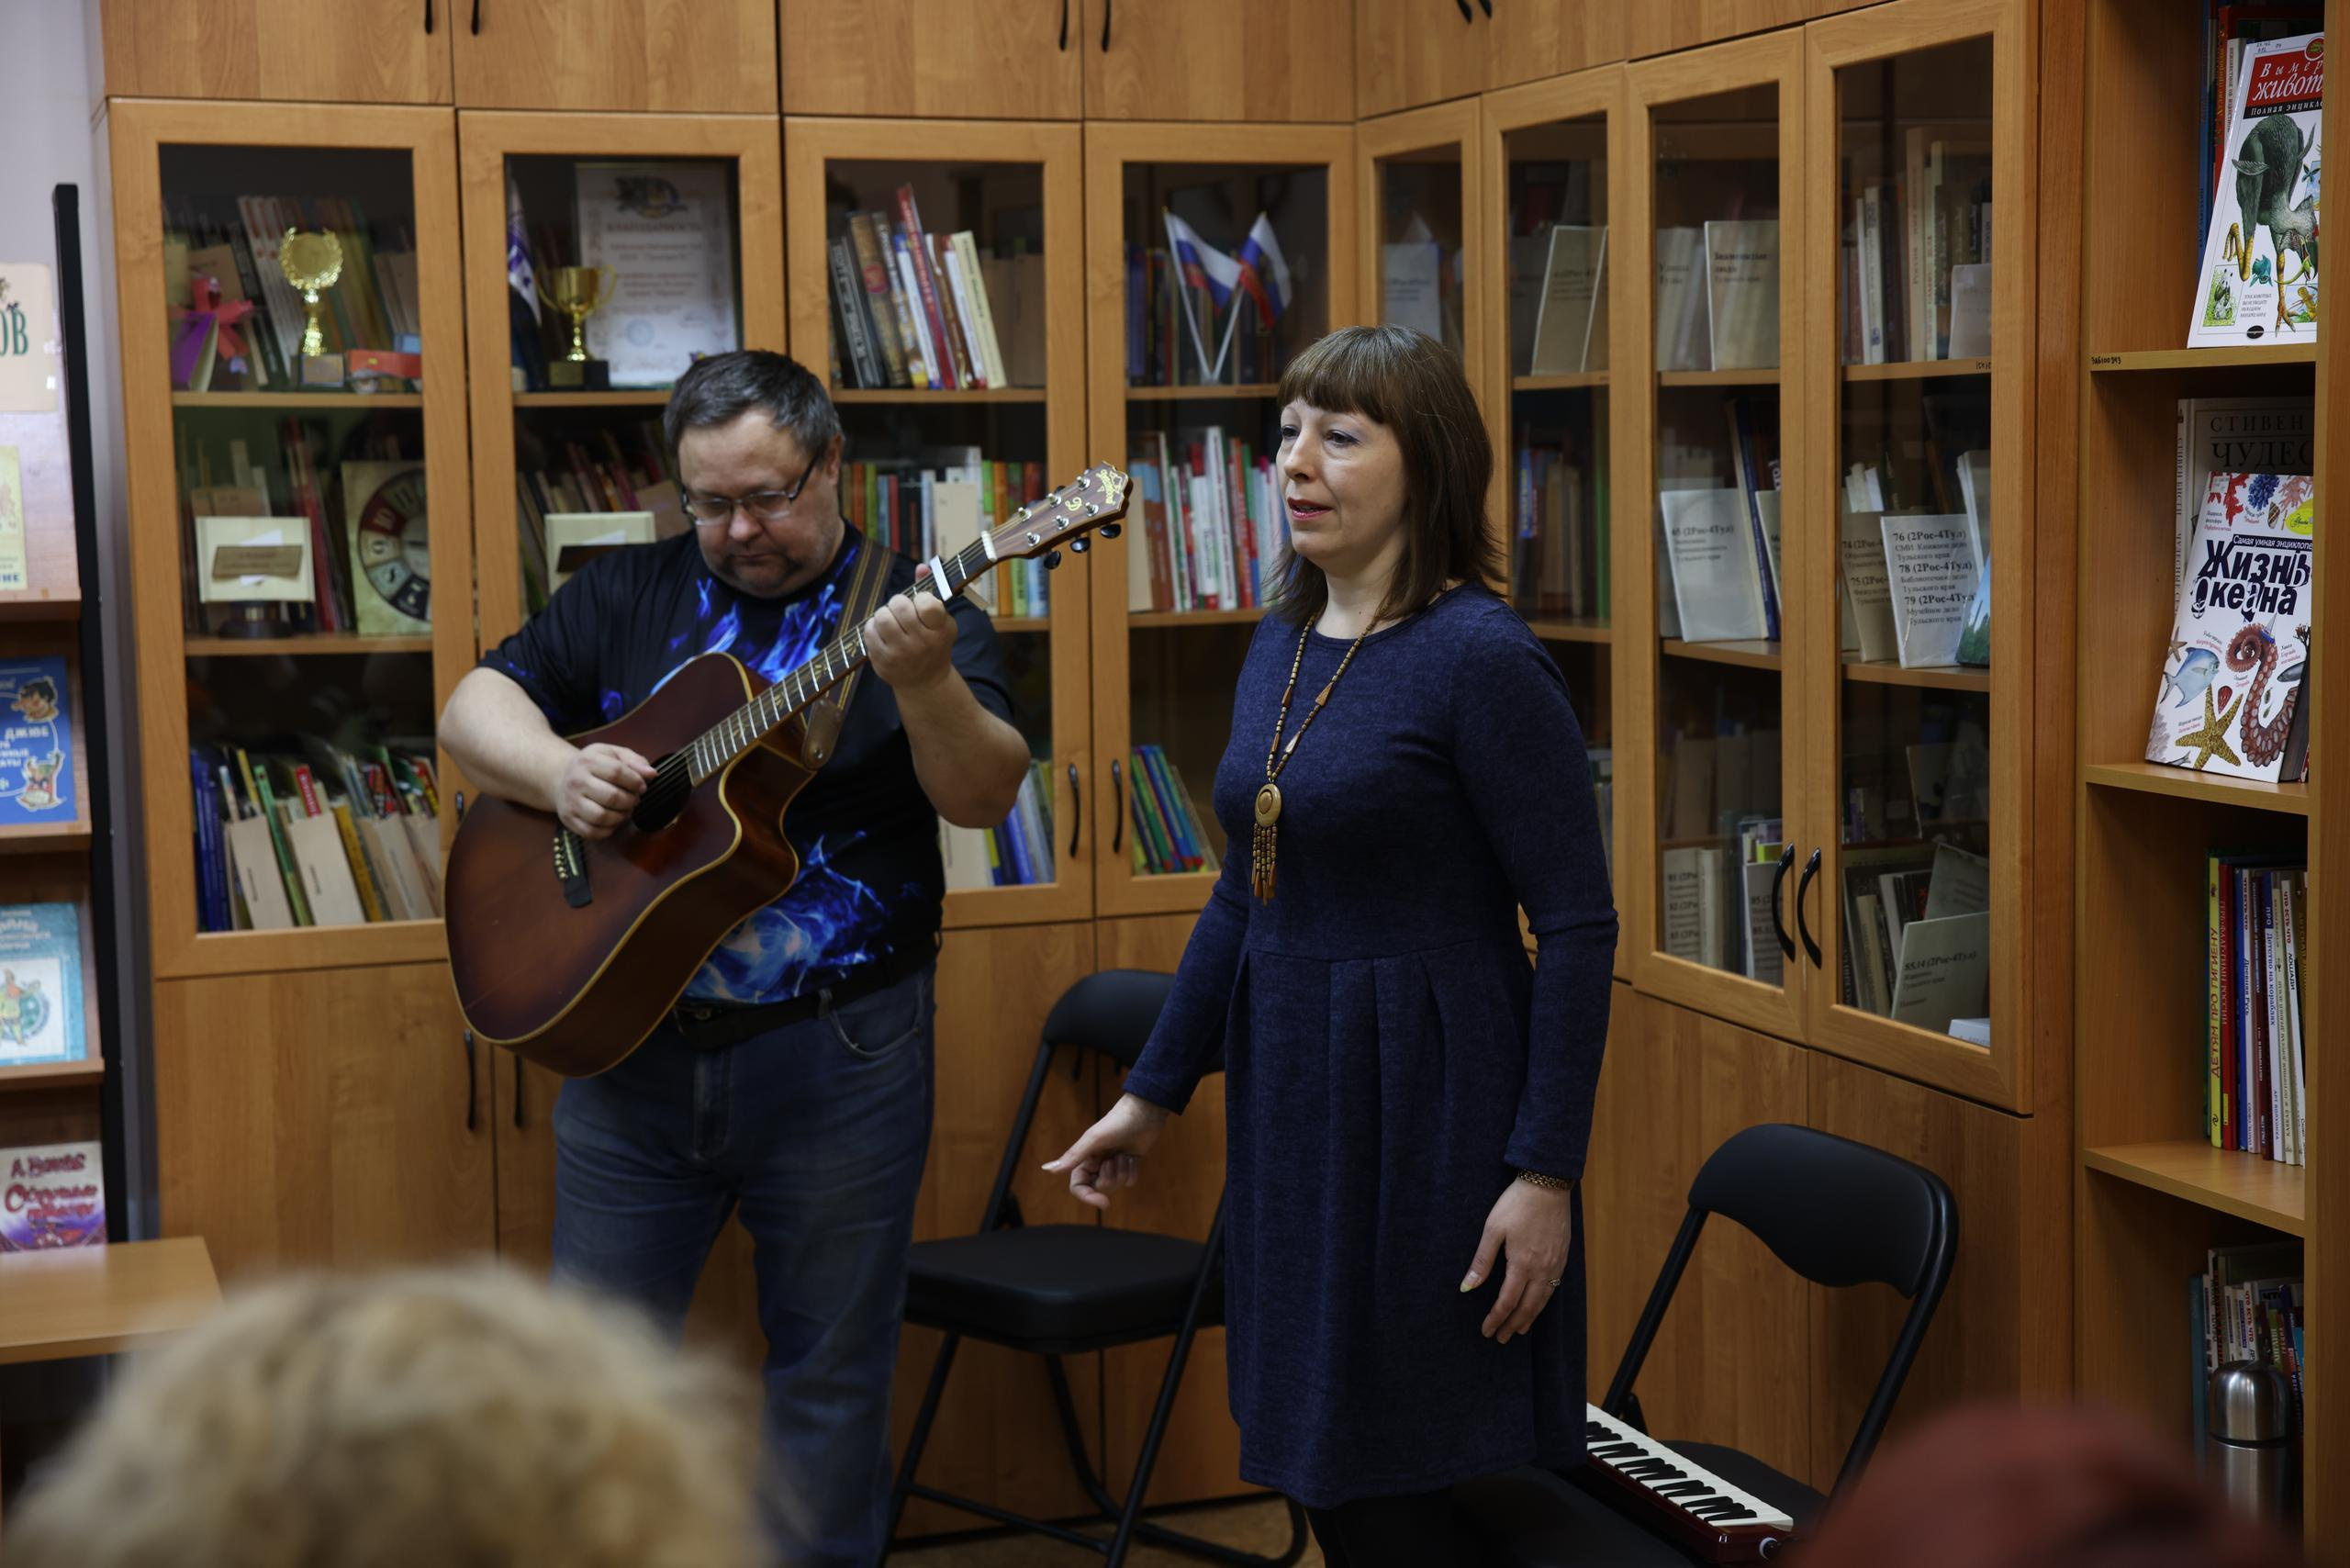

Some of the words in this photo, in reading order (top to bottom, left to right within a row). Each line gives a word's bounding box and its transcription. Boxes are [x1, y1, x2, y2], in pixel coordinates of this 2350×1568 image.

[2210, 415, 2303, 432] СТИВЕН
[1892, 532, 1905, 541] 76
[2232, 534, 2254, 544] Самая
[2255, 538, 2275, 547] умная
[1898, 565, 1911, 573] 78
[1905, 597, 1916, 605] 79
[2266, 933, 2275, 969] Детство
[2210, 991, 2219, 1021] ПРО
[2210, 1025, 2220, 1079] ДЕТЯМ
